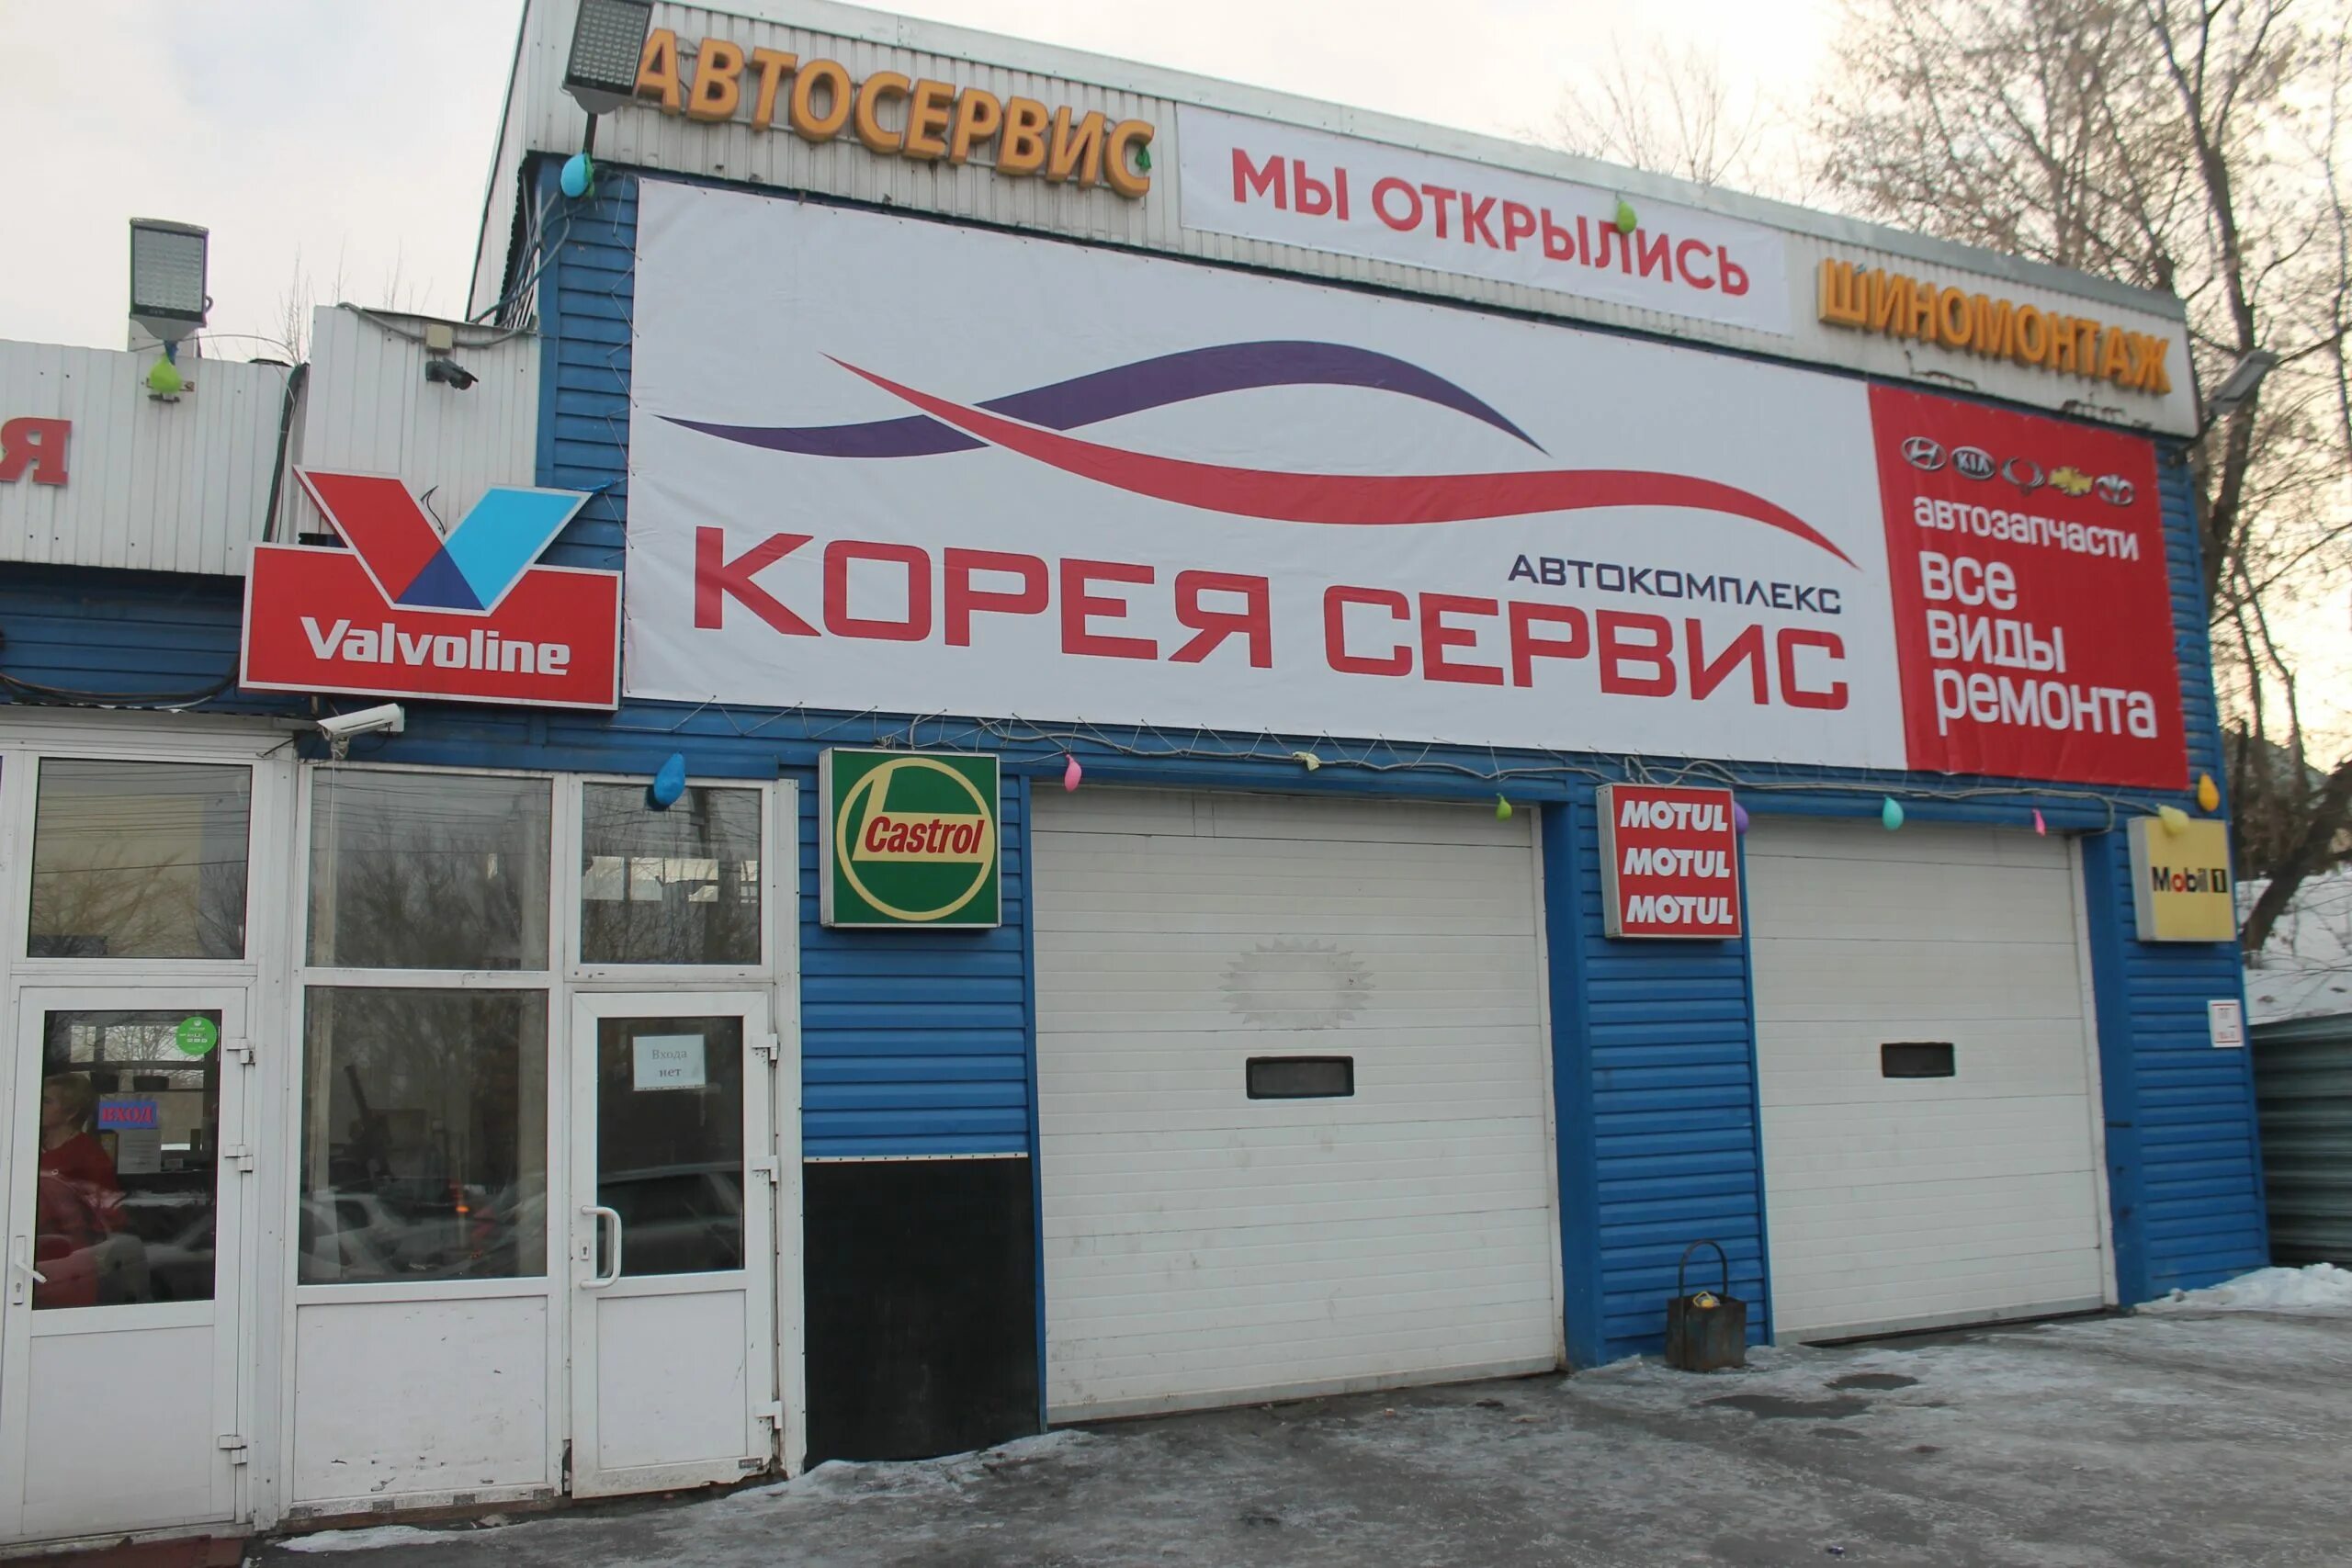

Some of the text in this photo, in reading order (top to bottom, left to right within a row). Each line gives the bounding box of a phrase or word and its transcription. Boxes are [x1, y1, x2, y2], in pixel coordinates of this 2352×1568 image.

[634, 27, 1155, 199] АВТОСЕРВИС
[1231, 148, 1750, 297] МЫ ОТКРЫЛИСЬ
[1817, 256, 2172, 396] ШИНОМОНТАЖ
[1956, 452, 1991, 474] KIA
[1913, 496, 2140, 561] автозапчасти
[1508, 554, 1842, 615] АВТОКОМПЛЕКС
[300, 616, 571, 676] Valvoline
[695, 525, 1849, 711] КОРЕЯ СЕРВИС
[1933, 668, 2158, 739] ремонта
[865, 816, 986, 854] Castrol
[1620, 799, 1729, 832] MOTUL
[1623, 847, 1732, 879] MOTUL
[1625, 894, 1735, 925] MOTUL
[650, 1048, 689, 1061] Входа
[101, 1106, 153, 1123] ВХОД
